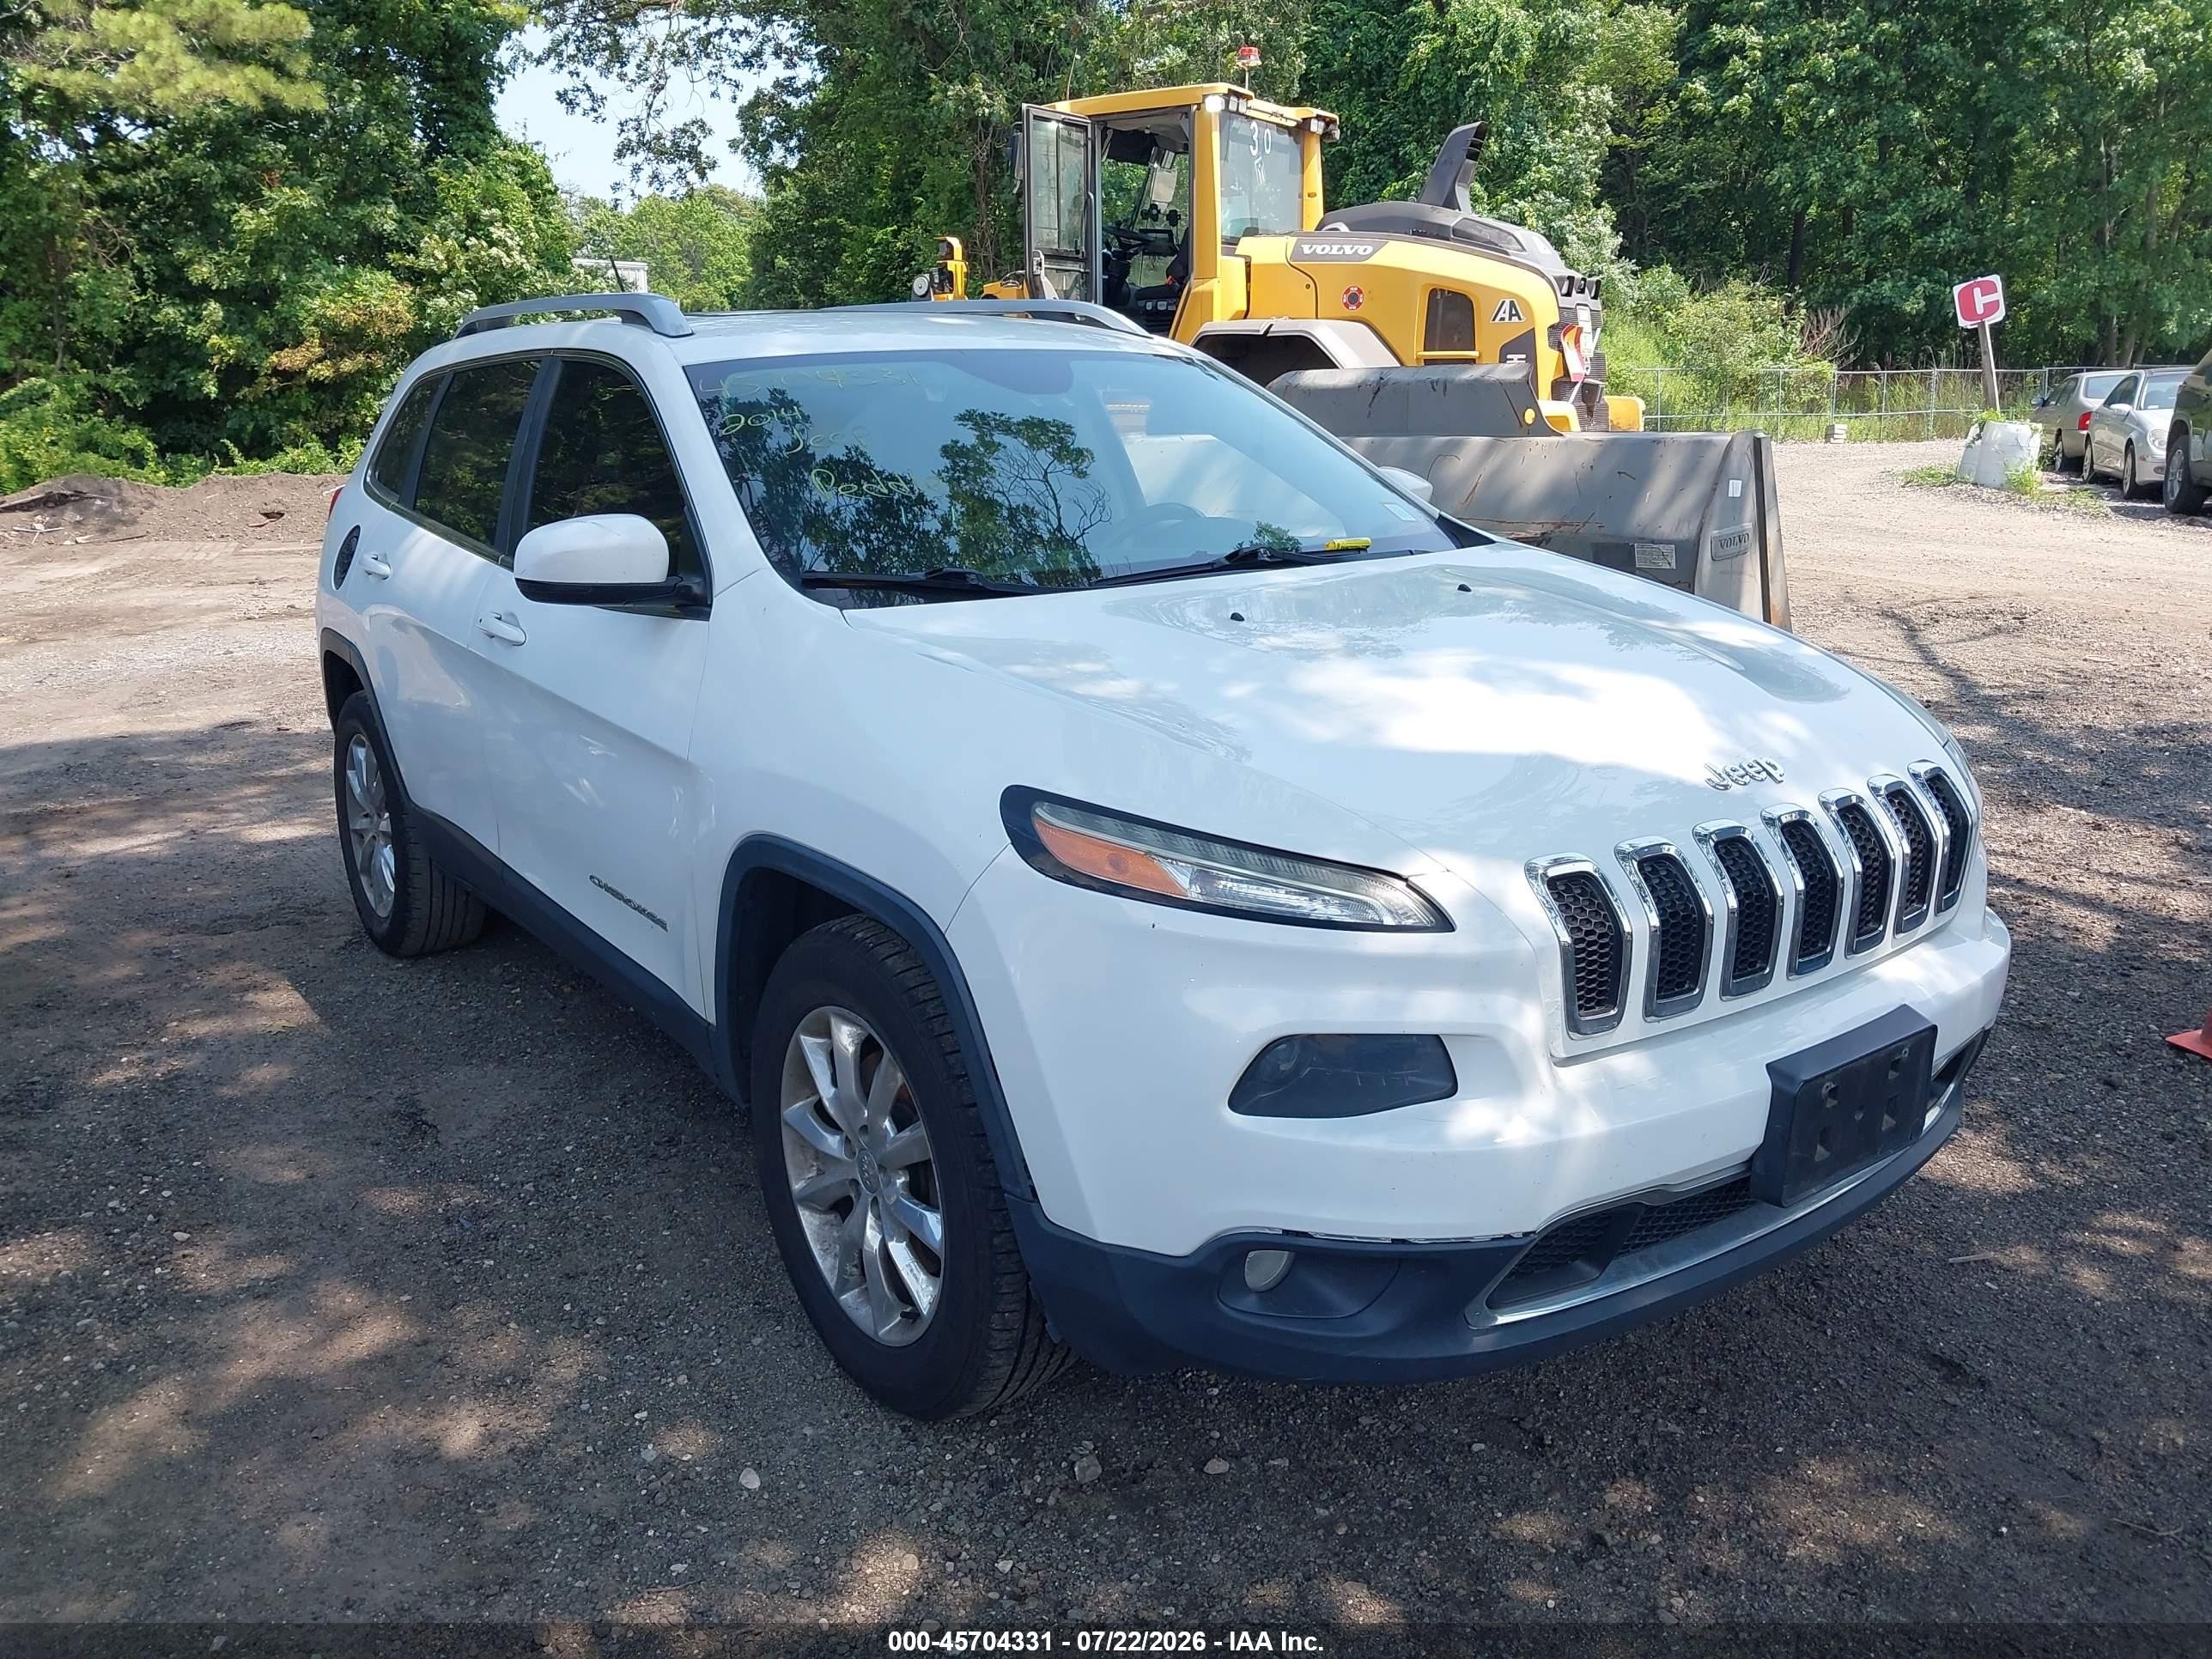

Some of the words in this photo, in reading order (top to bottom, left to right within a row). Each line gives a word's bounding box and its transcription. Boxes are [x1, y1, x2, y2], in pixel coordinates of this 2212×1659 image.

[1249, 120, 1272, 156] 30
[1300, 244, 1374, 256] VOLVO
[1957, 279, 2000, 322] C
[721, 406, 802, 435] 2014
[1719, 532, 1750, 550] VOLVO
[1704, 757, 1785, 791] Jeep
